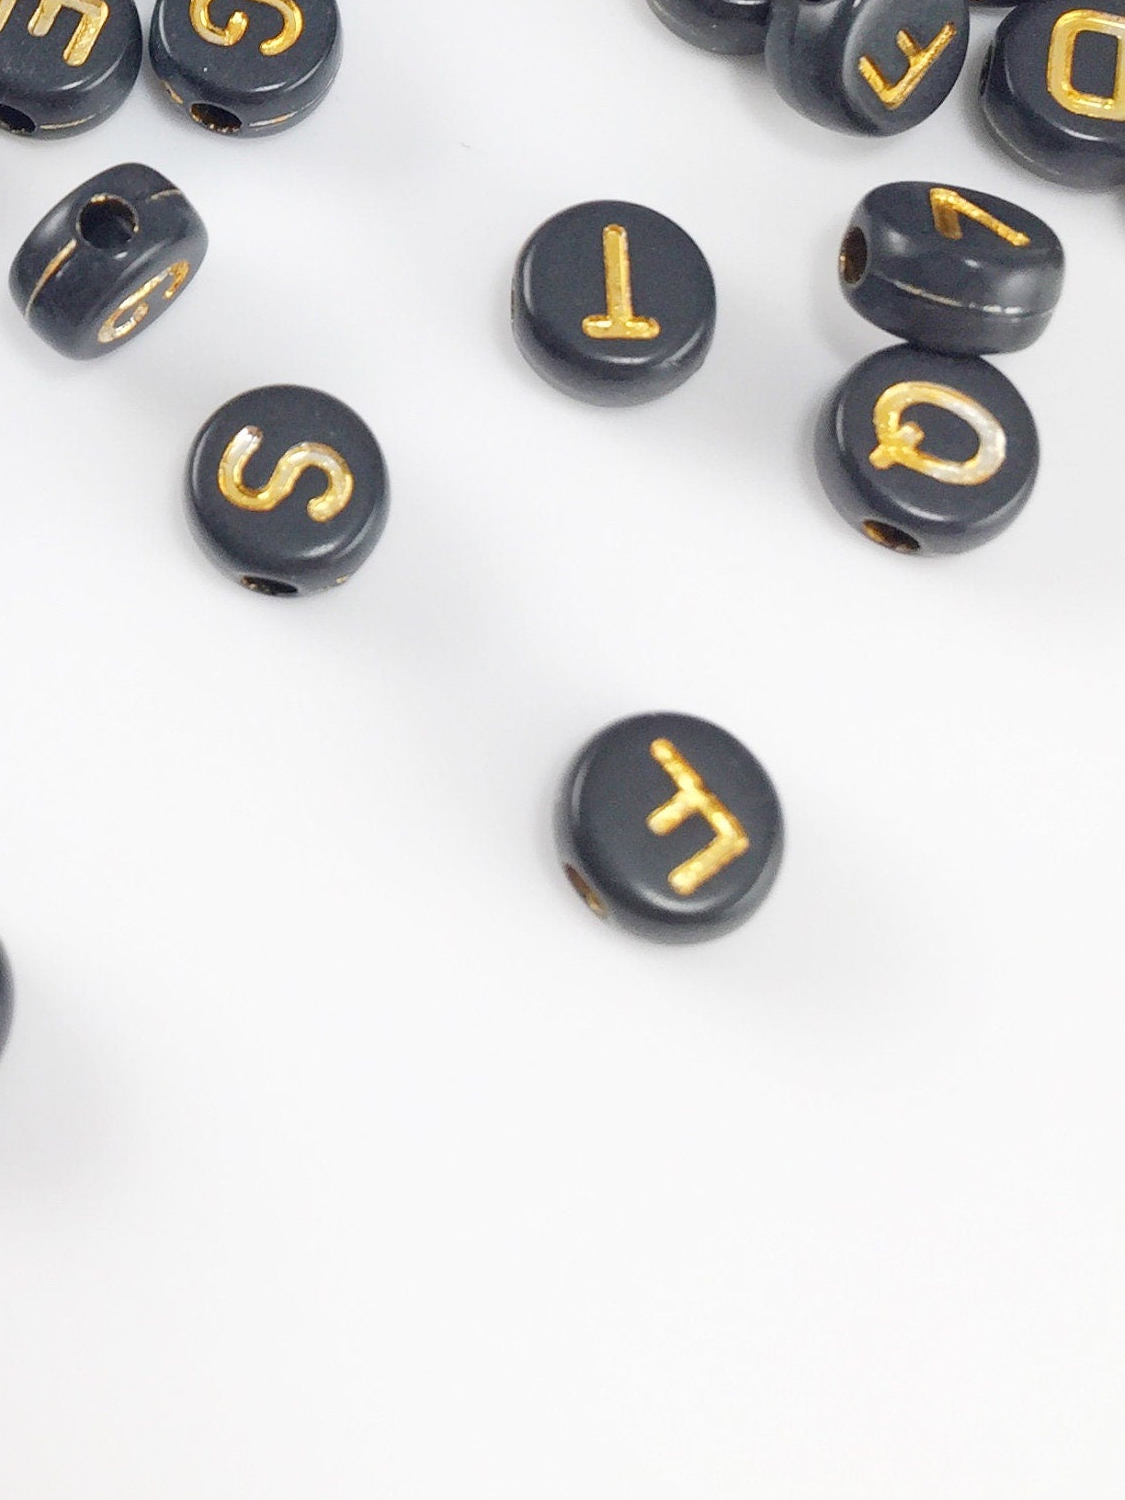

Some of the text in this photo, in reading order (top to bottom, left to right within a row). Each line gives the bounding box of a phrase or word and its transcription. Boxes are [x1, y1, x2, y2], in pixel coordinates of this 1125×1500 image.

[859, 24, 955, 107] F
[583, 225, 660, 339] T
[218, 429, 353, 521] S
[870, 382, 1003, 484] Q
[647, 739, 748, 895] F
